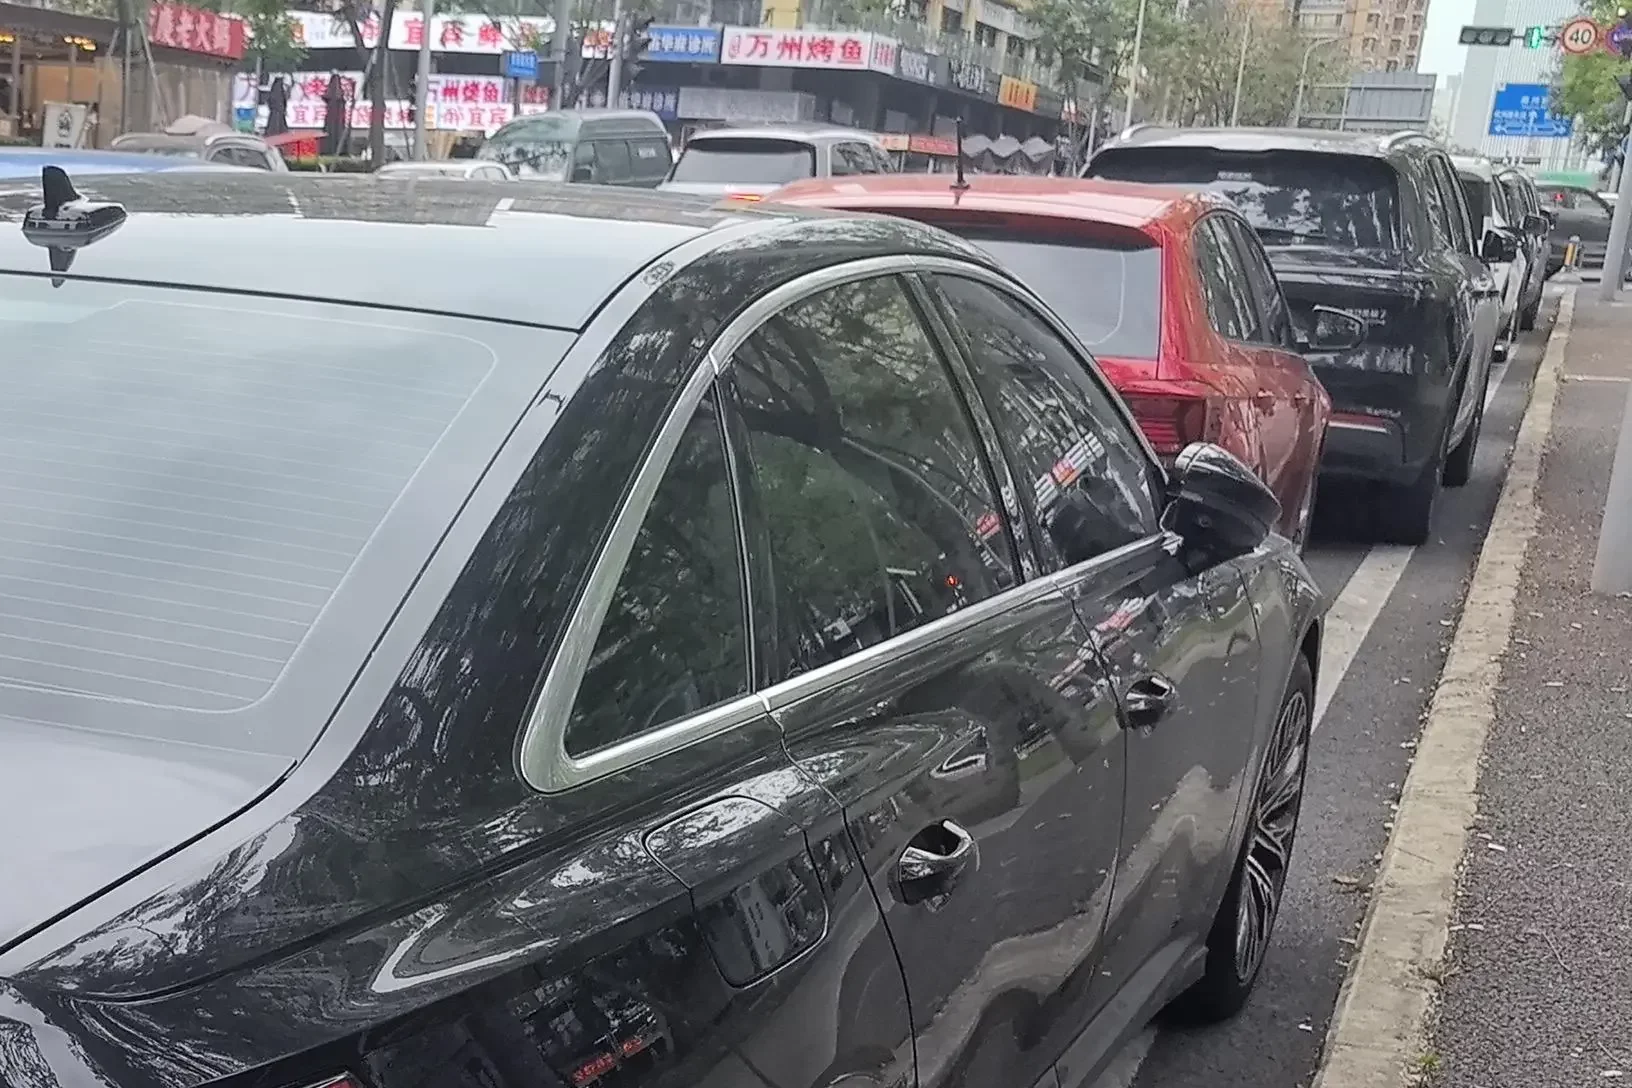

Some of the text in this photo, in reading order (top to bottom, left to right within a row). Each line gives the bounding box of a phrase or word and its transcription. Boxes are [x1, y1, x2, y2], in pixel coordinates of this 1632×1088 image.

[1570, 28, 1592, 44] 40
[745, 33, 864, 64] 万州烤鱼
